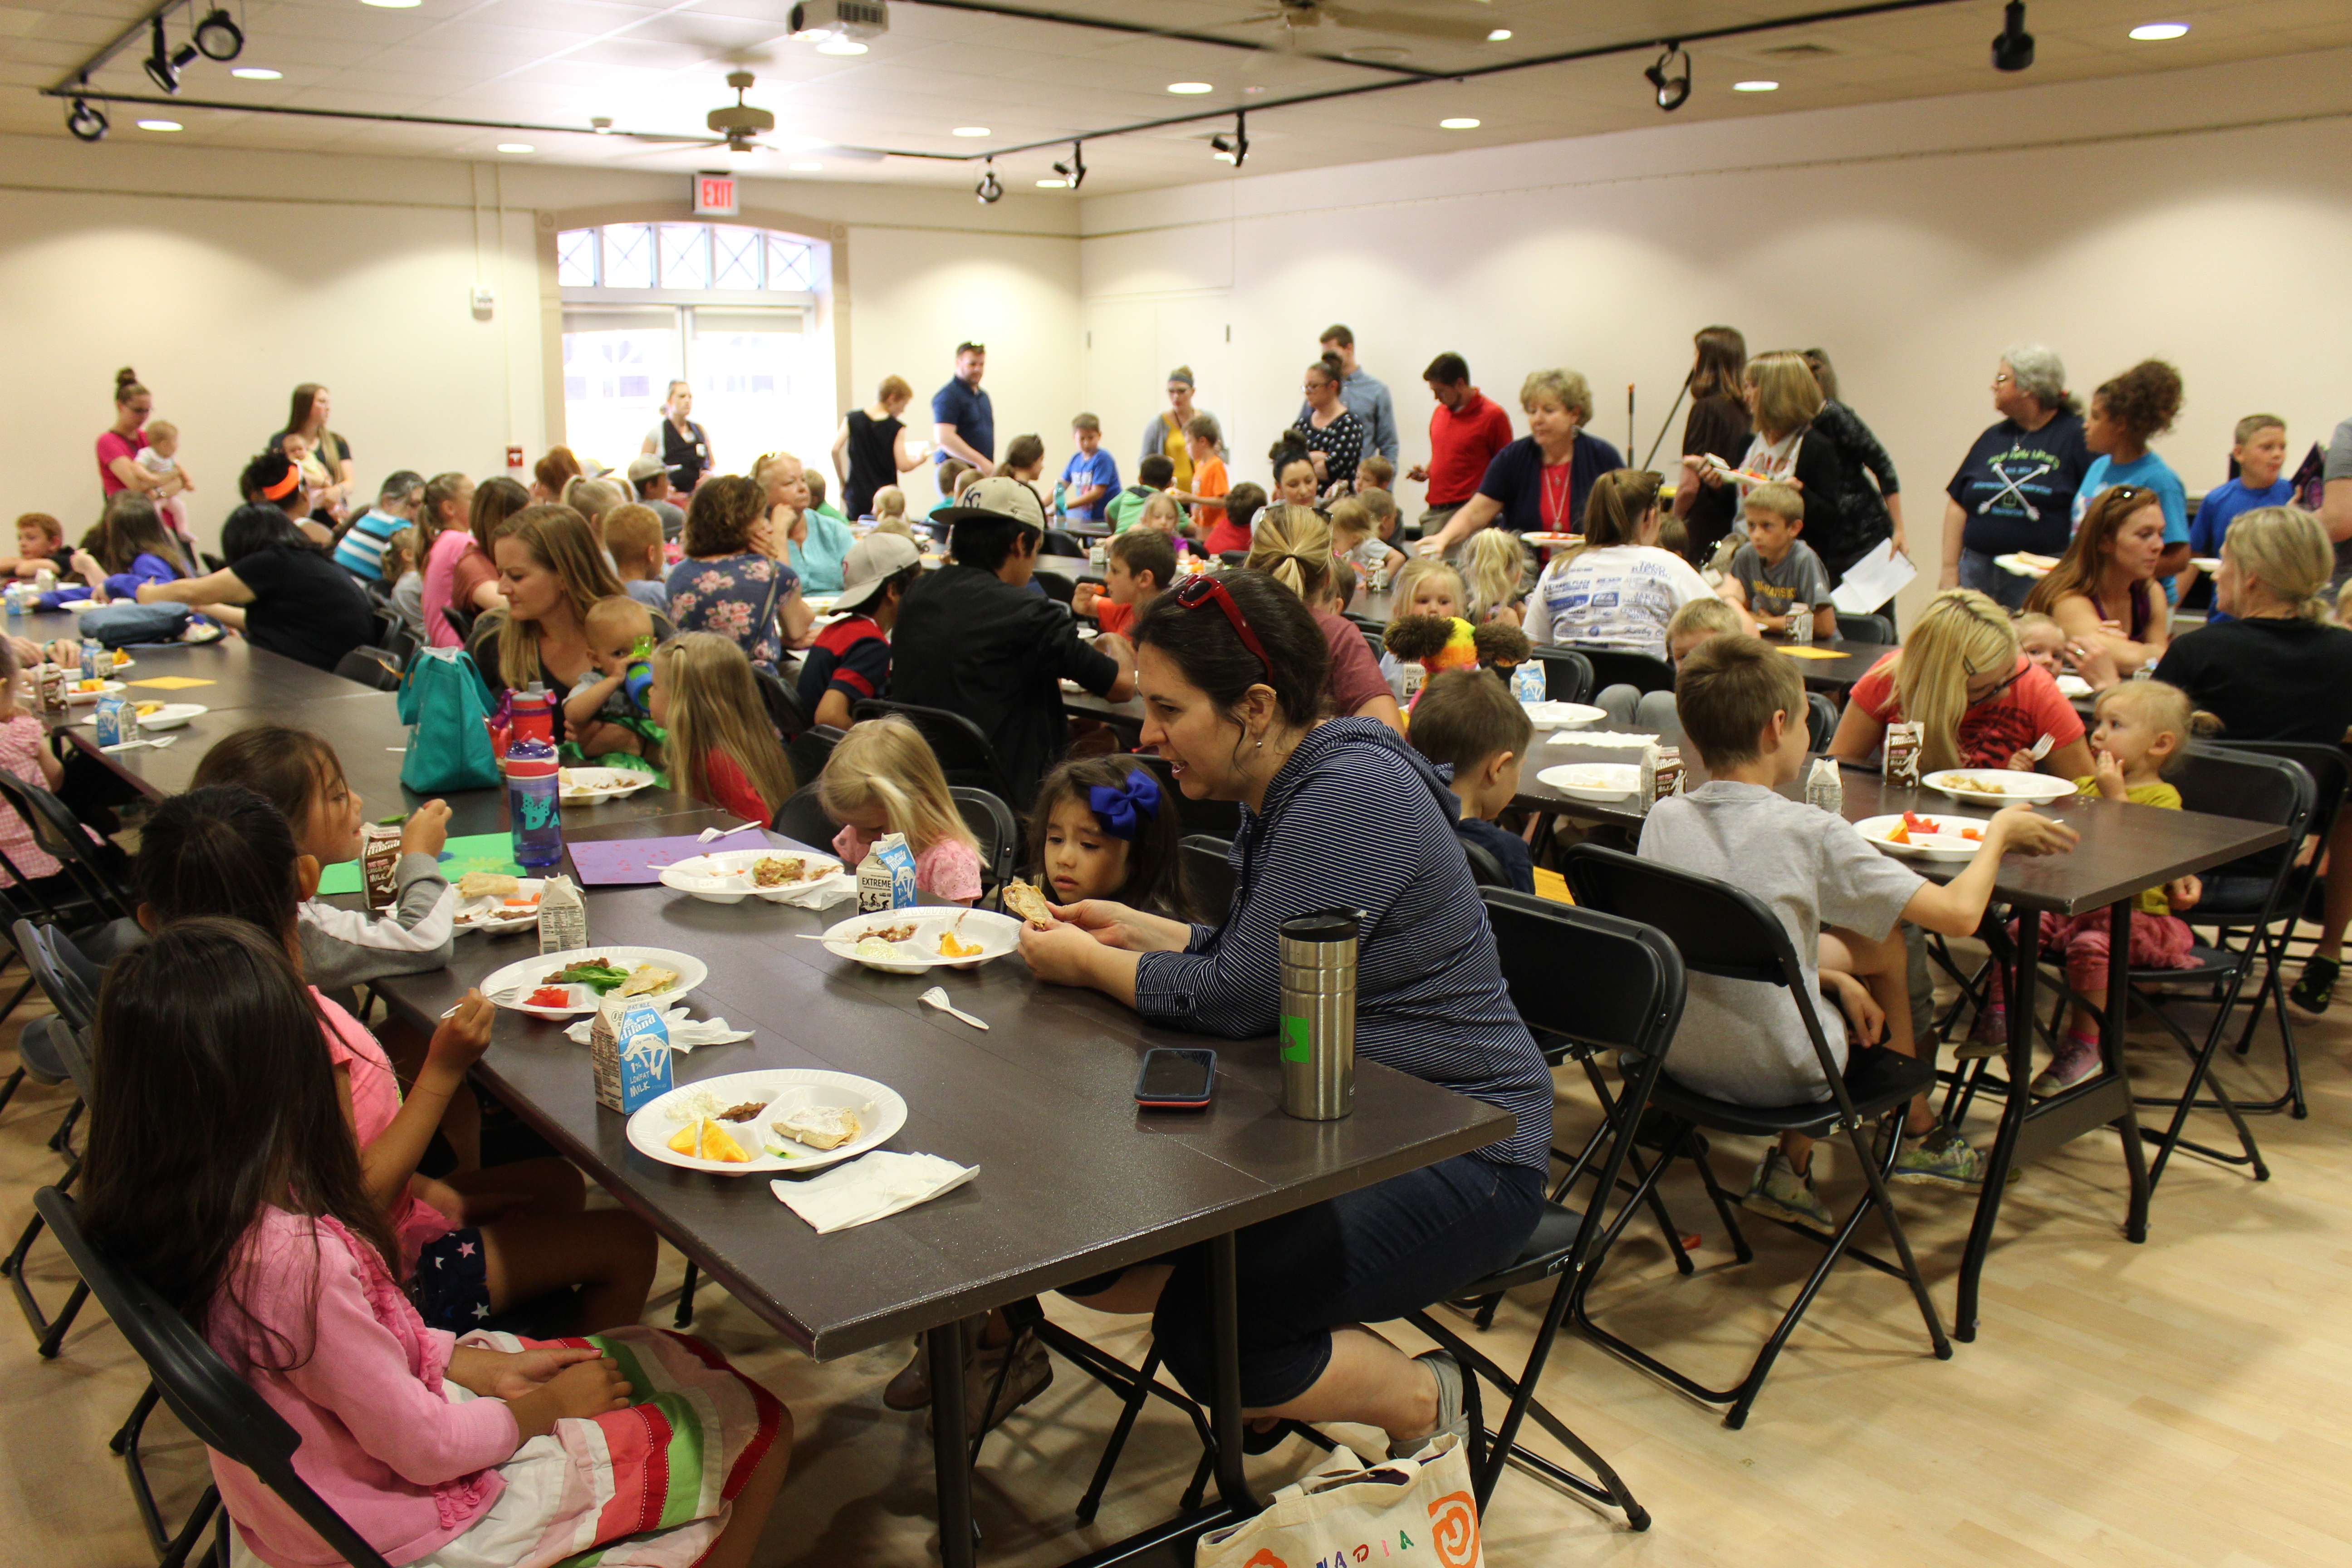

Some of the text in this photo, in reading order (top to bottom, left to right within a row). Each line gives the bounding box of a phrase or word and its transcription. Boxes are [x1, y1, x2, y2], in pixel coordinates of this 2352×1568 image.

[701, 179, 734, 207] EXIT
[962, 486, 981, 508] KC
[370, 873, 387, 883] MILK
[862, 877, 892, 888] EXTREME
[630, 1062, 642, 1073] 1%
[630, 1070, 650, 1084] LOWFAT
[630, 1081, 651, 1098] MILK
